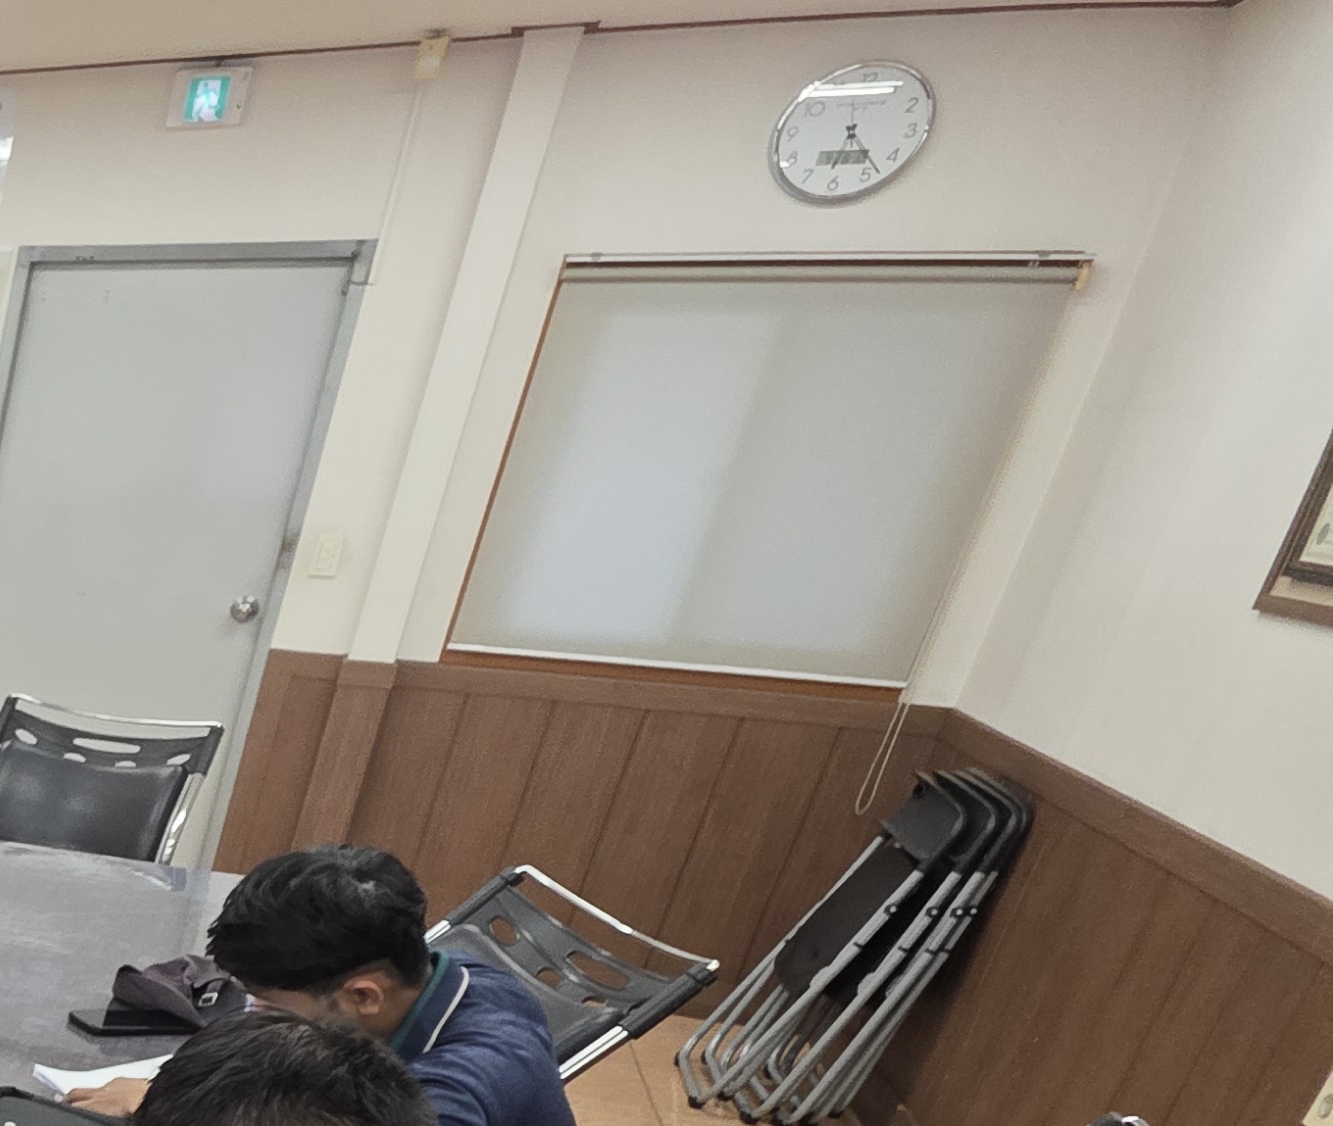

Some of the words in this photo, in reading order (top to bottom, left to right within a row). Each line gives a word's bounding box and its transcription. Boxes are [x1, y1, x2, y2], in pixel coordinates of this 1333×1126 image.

[803, 101, 827, 118] 10
[904, 97, 920, 114] 2
[786, 126, 800, 142] 9
[904, 122, 919, 139] 3
[885, 147, 900, 164] 4
[800, 169, 814, 185] 7
[826, 175, 840, 191] 6
[859, 167, 872, 183] 5
